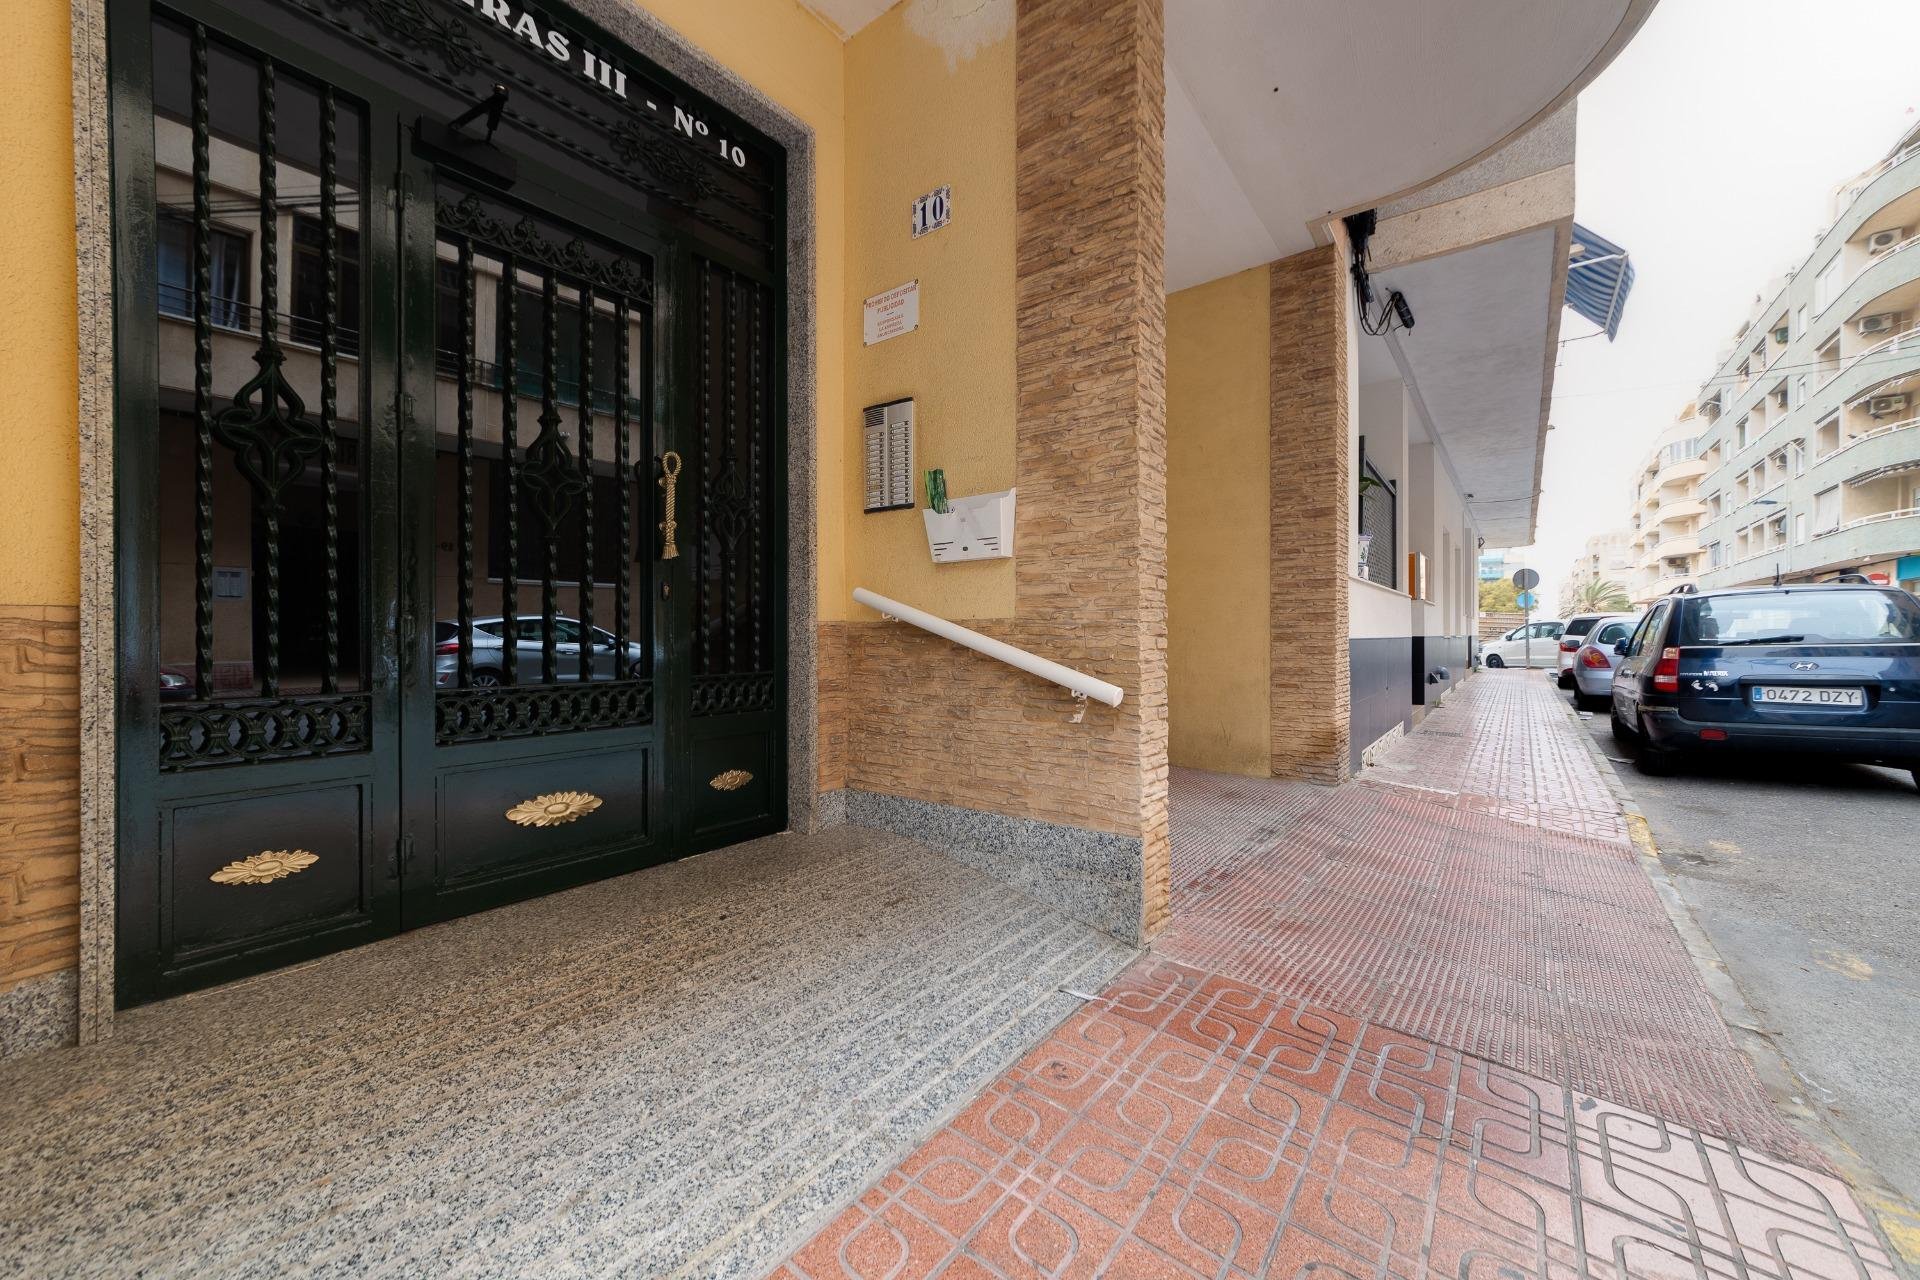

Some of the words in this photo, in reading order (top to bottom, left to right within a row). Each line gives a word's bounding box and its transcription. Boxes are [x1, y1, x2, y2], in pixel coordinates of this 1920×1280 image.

[461, 0, 571, 62] RAS
[582, 49, 627, 99] III
[719, 139, 746, 168] 10
[920, 195, 944, 228] 10
[1766, 689, 1813, 702] 0472
[1819, 690, 1855, 703] DZY
